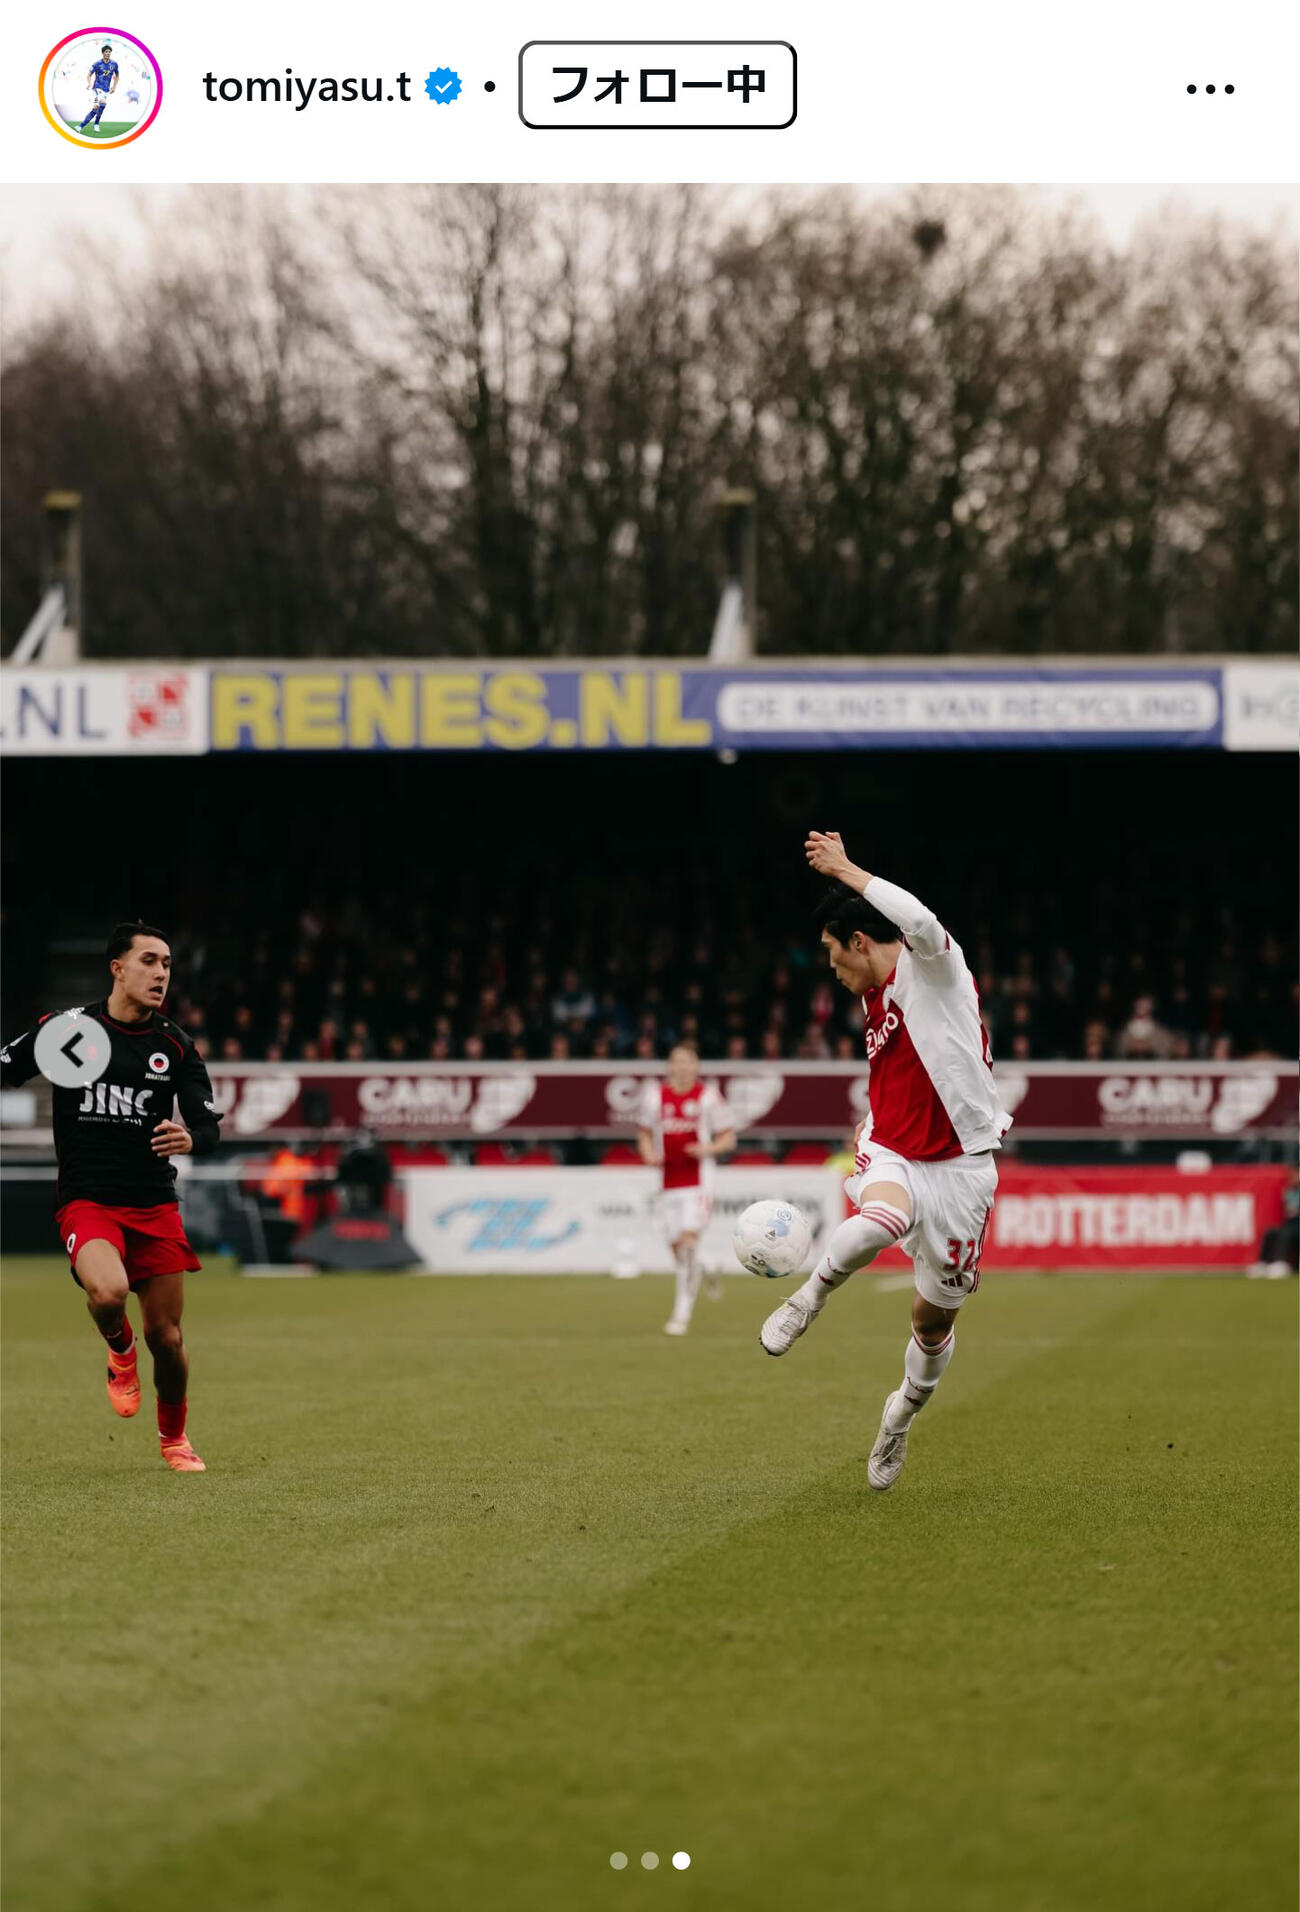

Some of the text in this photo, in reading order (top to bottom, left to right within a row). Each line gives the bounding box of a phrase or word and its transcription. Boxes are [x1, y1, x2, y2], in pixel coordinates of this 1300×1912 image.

[210, 671, 713, 749] RENES.NL
[738, 691, 780, 722] DE
[925, 691, 992, 722] VAN
[1002, 691, 1202, 722] RECYCLING
[995, 1193, 1255, 1247] ROTTERDAM
